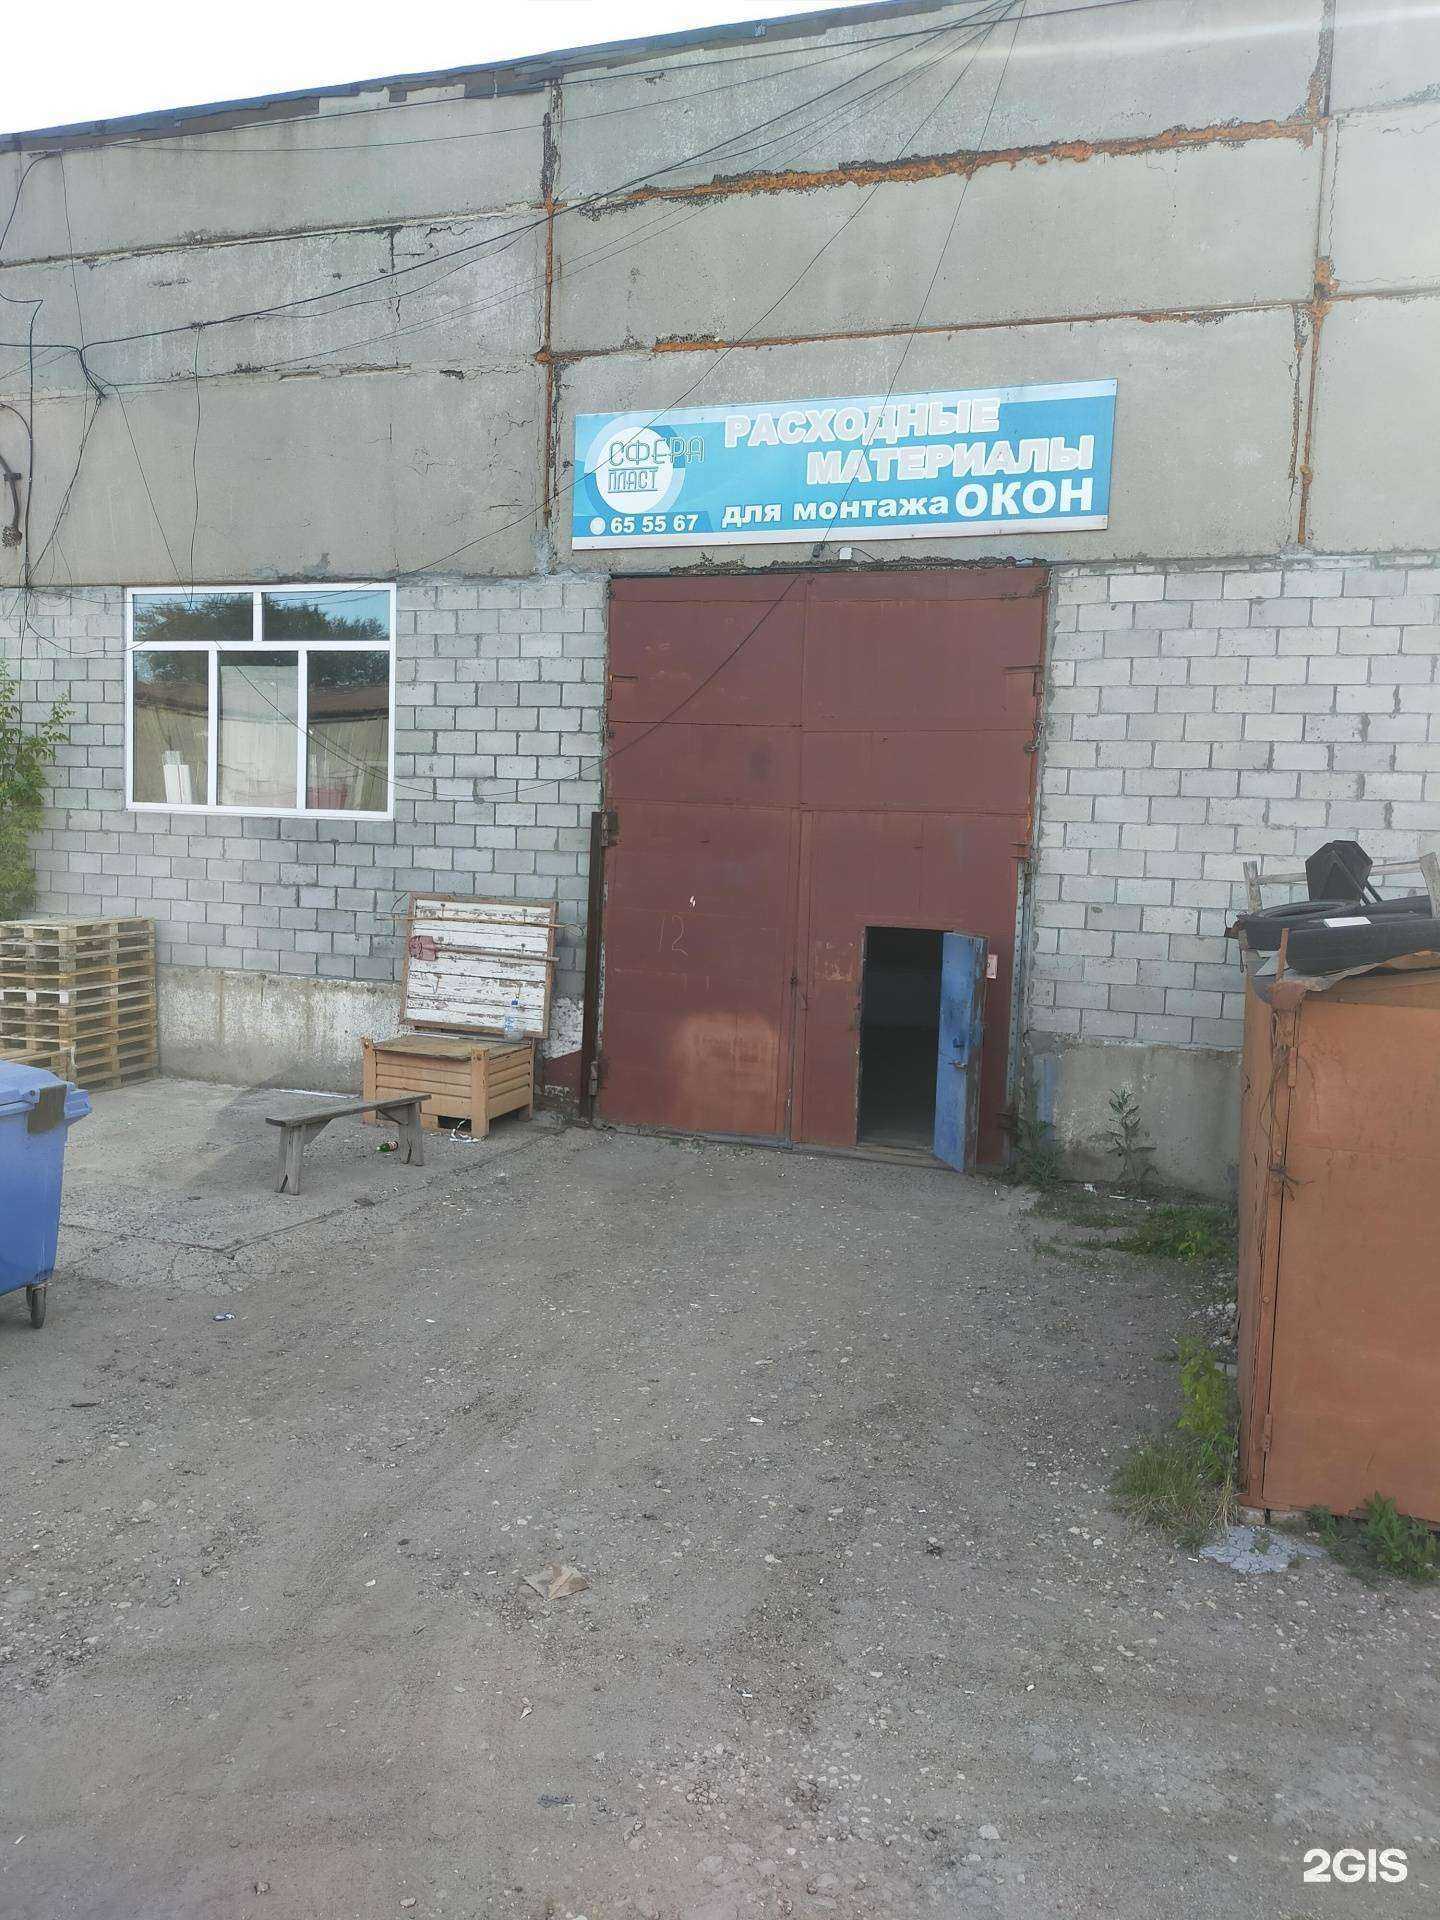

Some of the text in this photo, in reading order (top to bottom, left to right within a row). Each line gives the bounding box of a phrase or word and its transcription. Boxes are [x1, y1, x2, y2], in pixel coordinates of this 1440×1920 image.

[724, 398, 1001, 449] РАСХОДНЫЕ
[608, 434, 706, 467] СФЕРА
[806, 434, 1096, 487] МАТЕРИАЛЫ
[608, 467, 659, 493] ПЛАСТ
[610, 513, 700, 534] 65 55 67
[721, 502, 783, 529] для
[954, 476, 1095, 519] ОКОН
